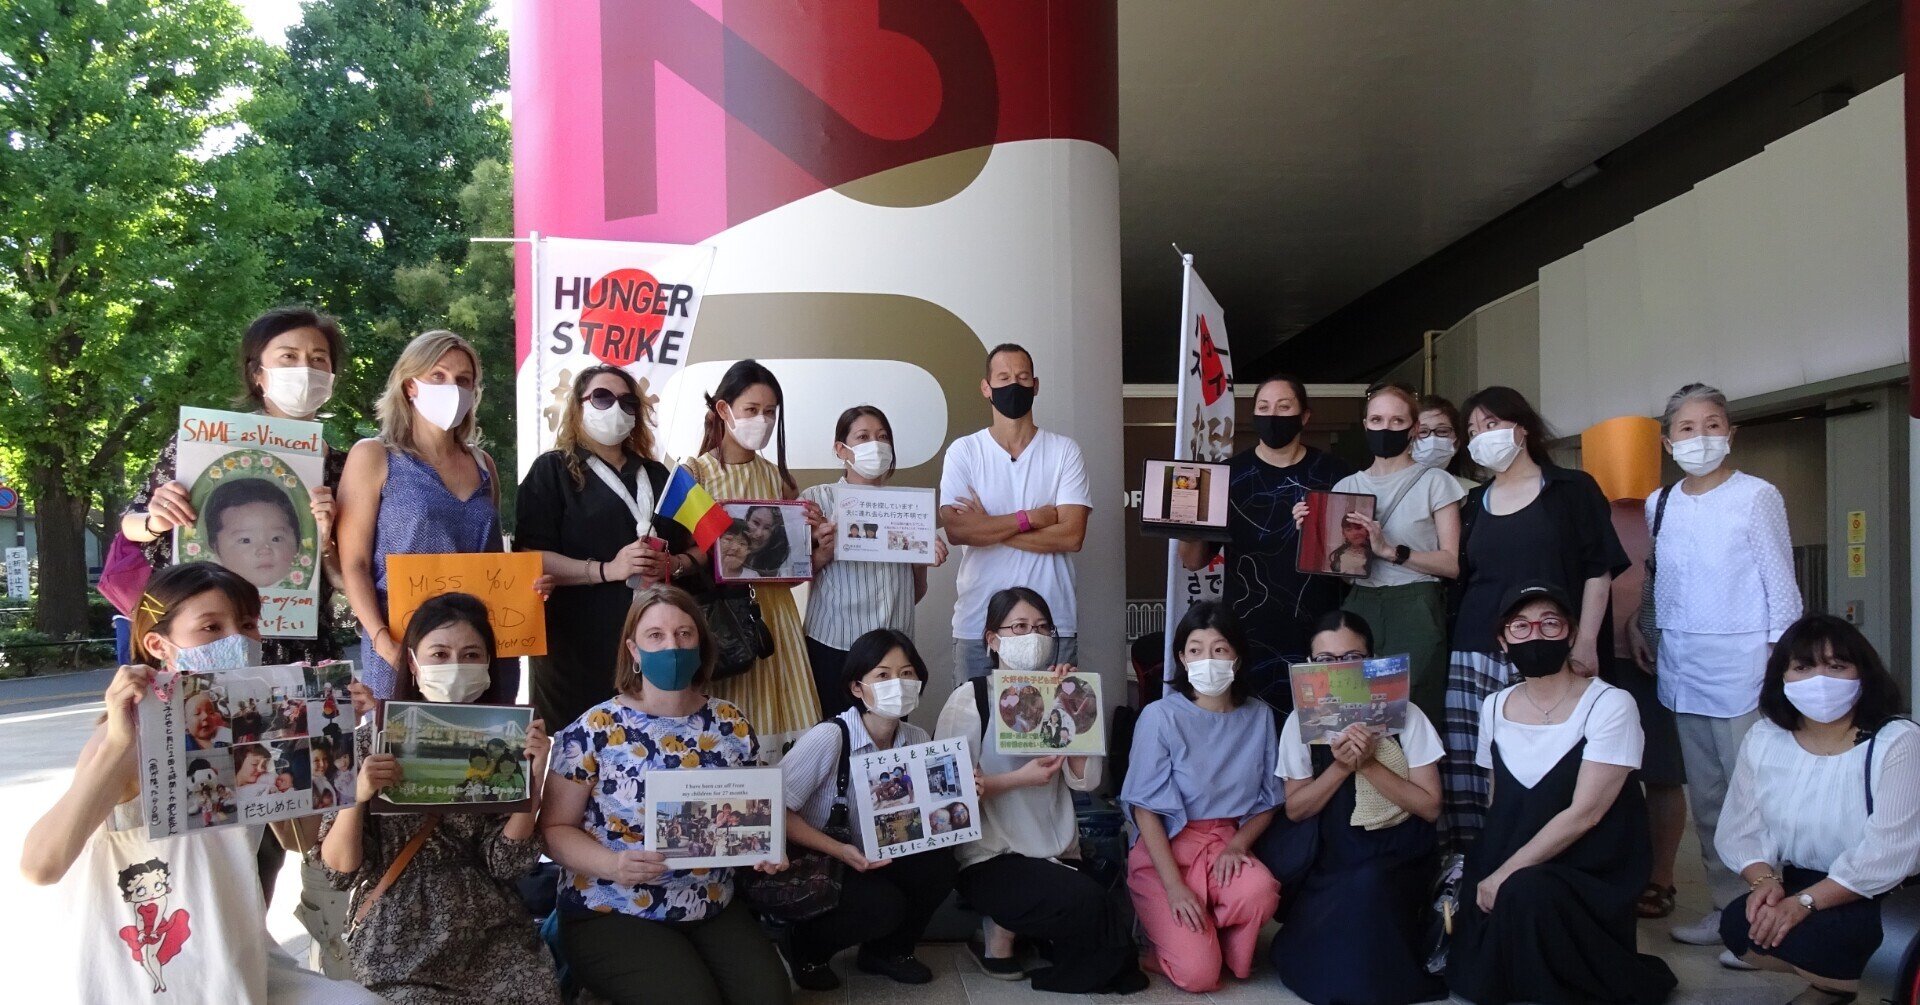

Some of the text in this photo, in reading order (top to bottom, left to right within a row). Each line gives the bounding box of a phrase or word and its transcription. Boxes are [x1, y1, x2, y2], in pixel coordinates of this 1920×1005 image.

[554, 276, 694, 318] HUNGER
[550, 321, 685, 366] STRIKE
[182, 418, 320, 452] SAME as Vincent
[408, 574, 463, 597] MISS
[864, 741, 963, 769] 子どもを返して
[244, 799, 309, 819] だきしめたい
[876, 831, 978, 860] 子どもに会いたい
